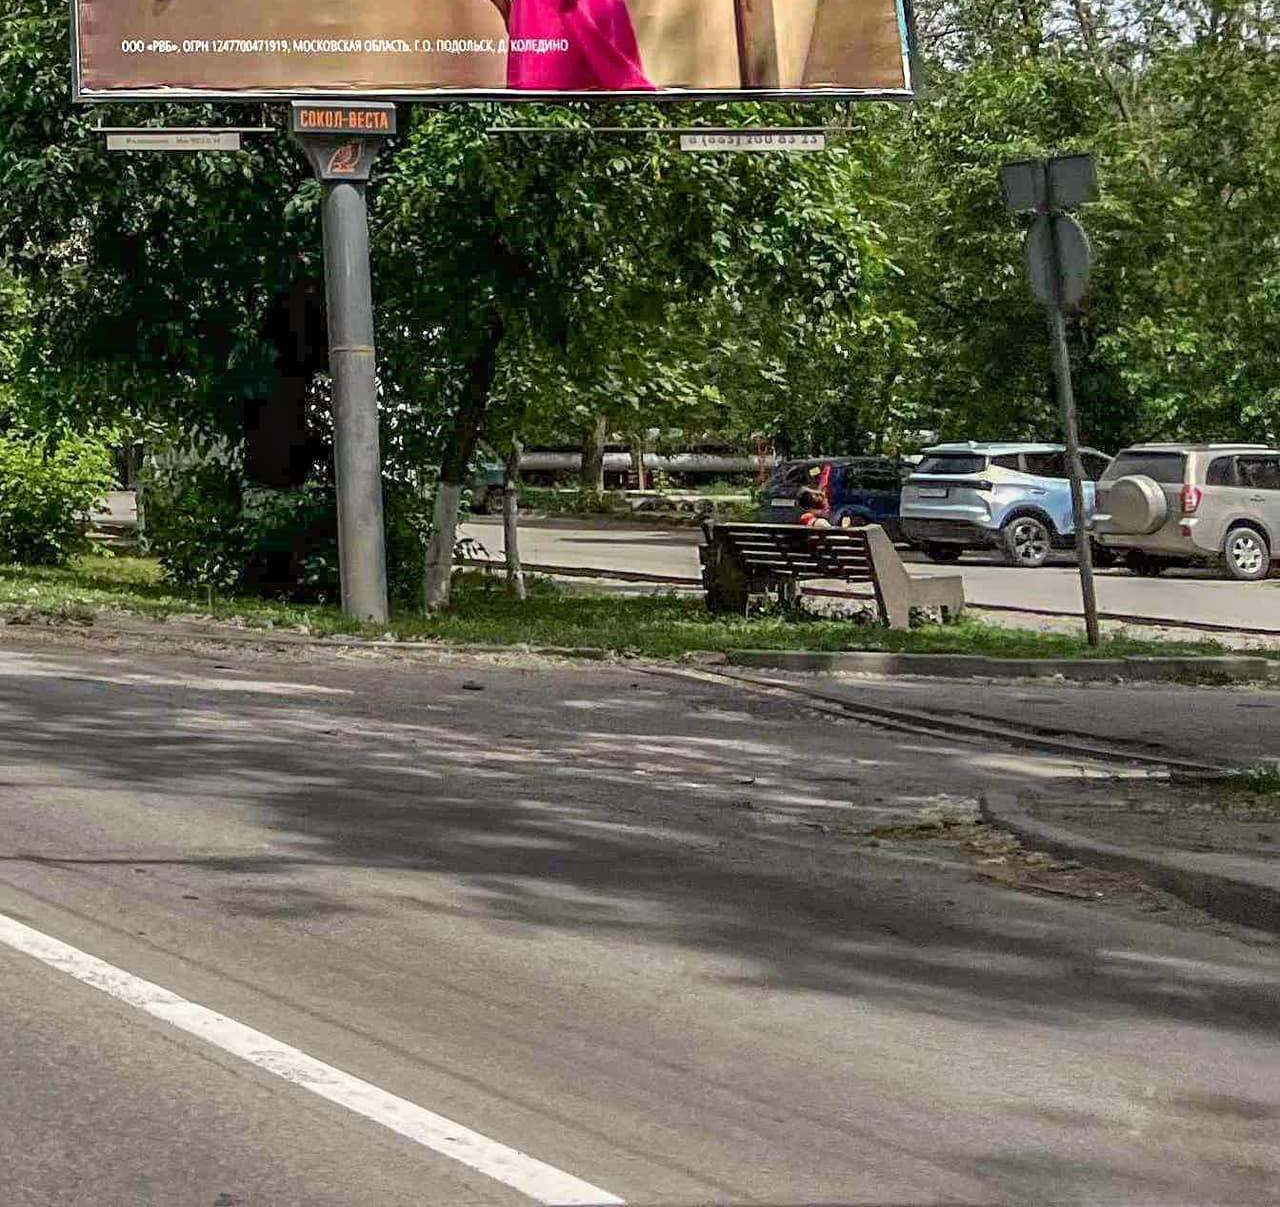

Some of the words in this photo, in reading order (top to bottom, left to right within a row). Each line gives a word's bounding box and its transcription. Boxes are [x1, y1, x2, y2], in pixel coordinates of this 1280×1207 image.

[121, 39, 144, 53] ООО
[182, 39, 209, 53] ОГРН
[292, 39, 362, 53] МОСКОВСКАЯ
[510, 38, 570, 54] КОЛЕДИНО
[299, 109, 390, 130] СОКОЛ-ВЕСТА
